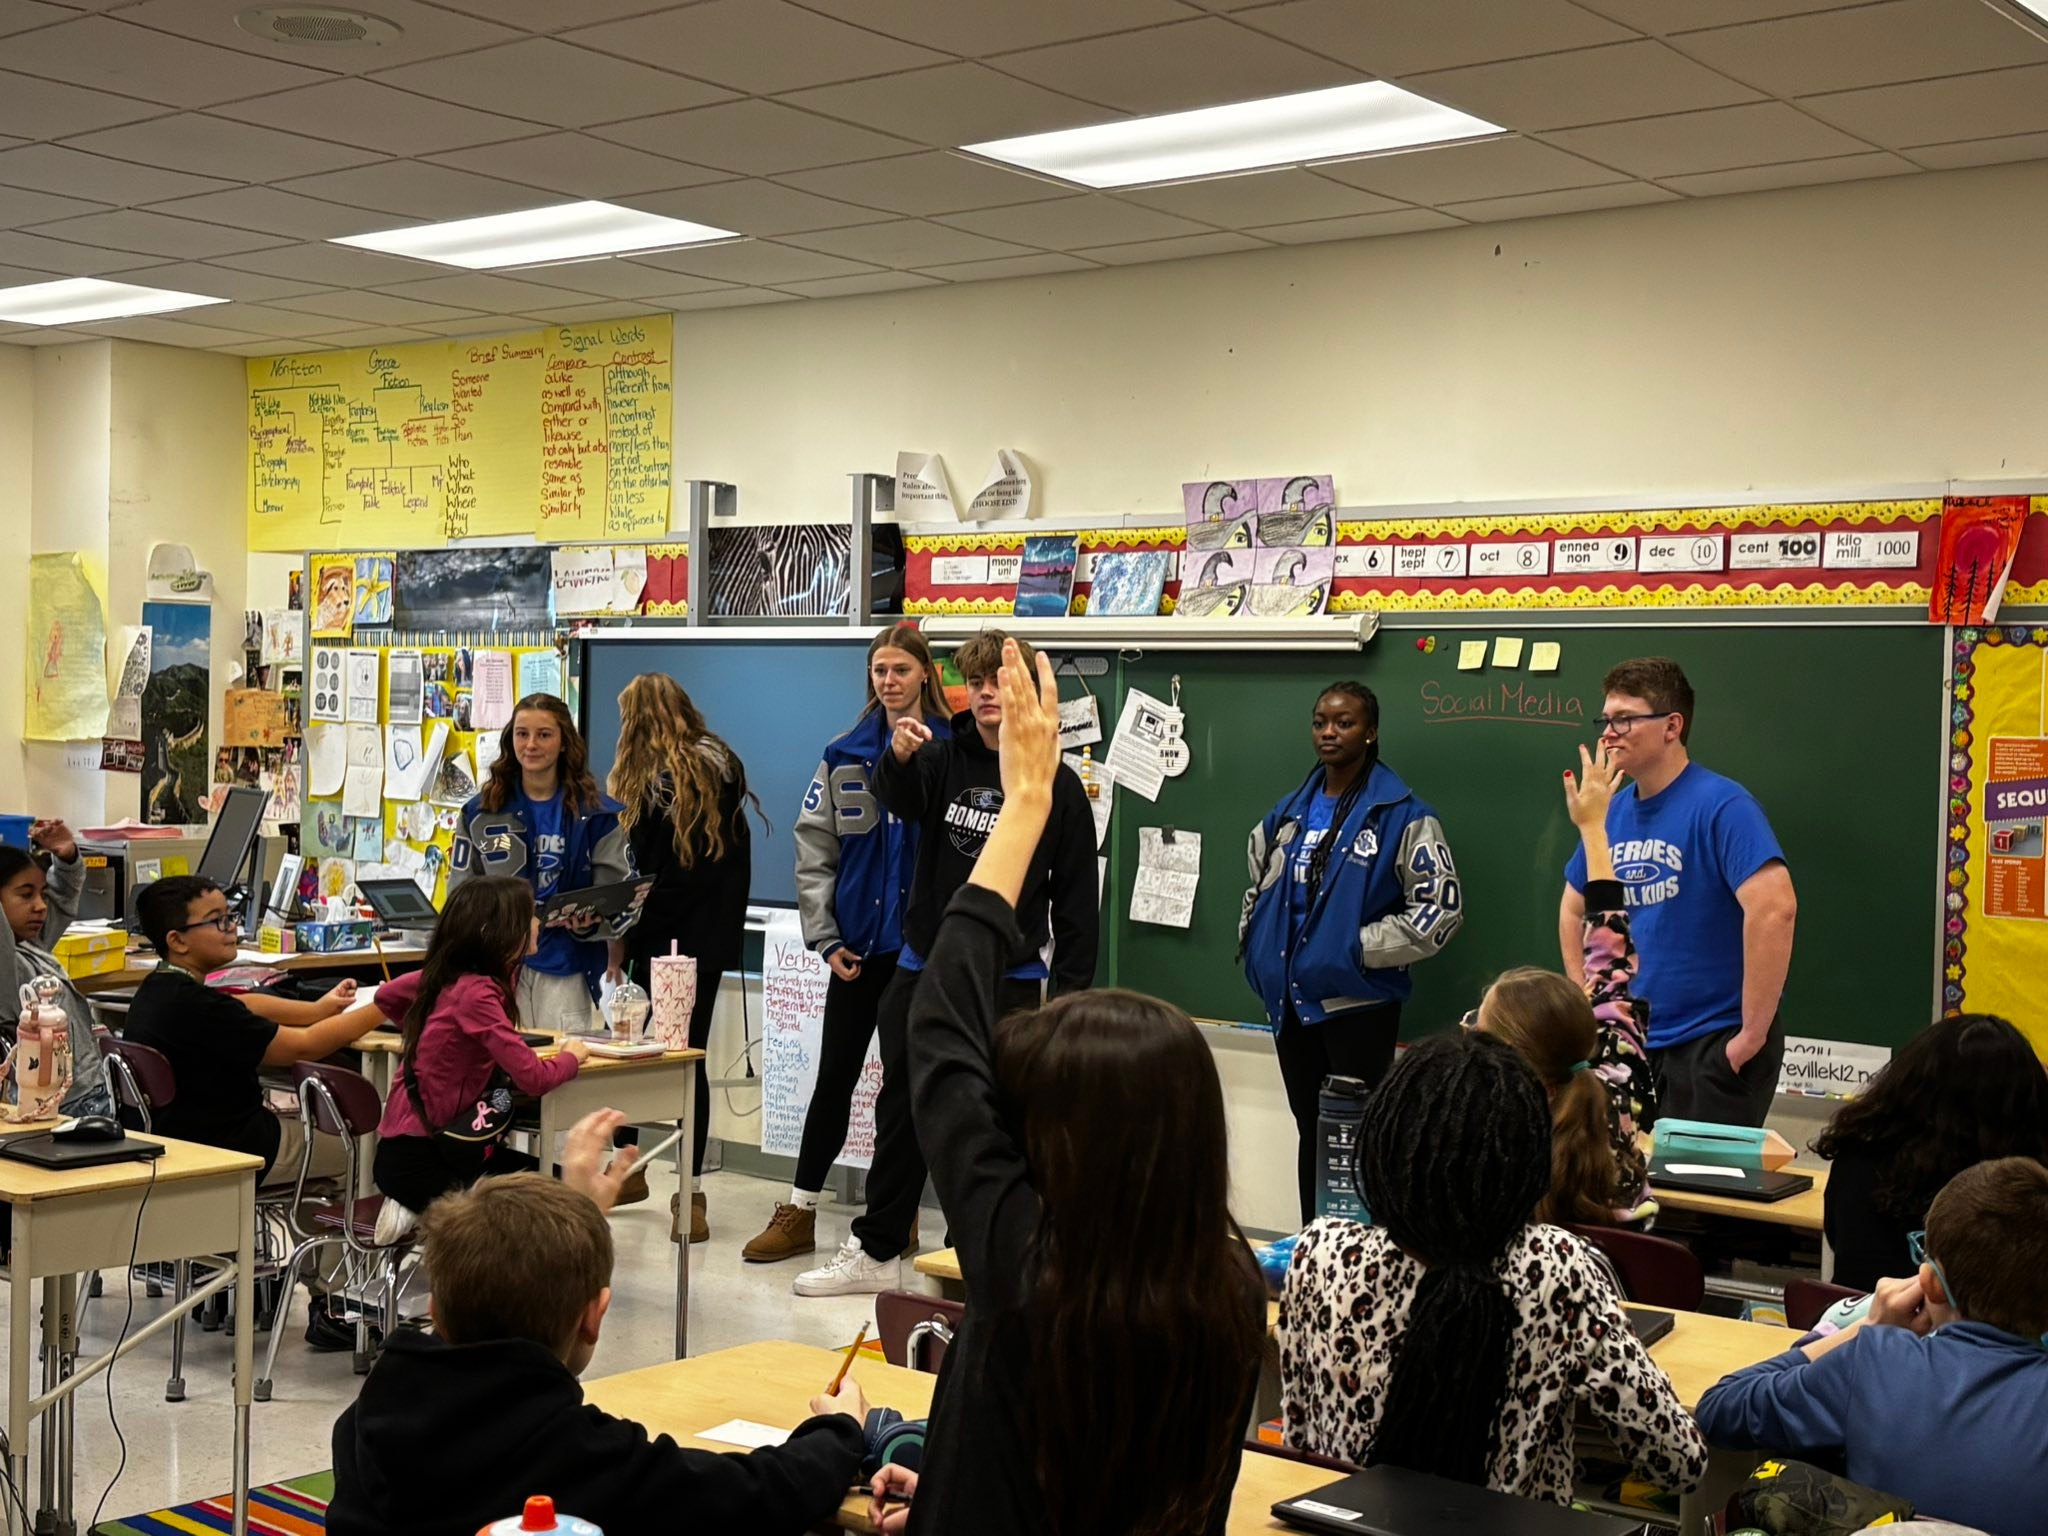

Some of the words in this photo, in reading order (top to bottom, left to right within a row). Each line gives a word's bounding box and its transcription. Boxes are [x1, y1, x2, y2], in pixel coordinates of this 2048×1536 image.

[560, 328, 603, 350] Signal
[611, 325, 646, 343] Words
[466, 346, 498, 363] Brief
[502, 343, 544, 359] Summary
[613, 348, 656, 364] Contrast
[452, 400, 473, 413] But
[452, 413, 466, 425] So
[449, 453, 469, 468] Who
[447, 468, 475, 481] What
[447, 481, 473, 495] When
[577, 485, 585, 498] to
[446, 494, 476, 509] Where
[446, 507, 468, 521] Why
[1559, 541, 1600, 552] ennea
[1837, 534, 1862, 546] kilo
[1877, 540, 1911, 555] 1000
[1401, 547, 1427, 559] hept
[1566, 553, 1591, 564] non
[1614, 543, 1629, 561] 9
[1649, 545, 1675, 557] dec
[1697, 543, 1713, 559] 10
[1738, 541, 1769, 554] cent
[1780, 540, 1817, 557] 100
[992, 558, 1018, 566] mono
[1335, 555, 1349, 563] ex
[1368, 551, 1378, 568] 6
[1400, 557, 1425, 570] sept
[1444, 551, 1454, 568] 7
[1480, 551, 1500, 562] oct
[1523, 551, 1533, 566] 8
[998, 567, 1011, 576] uni
[1421, 680, 1492, 716] Social
[1502, 681, 1584, 717] Media
[1160, 750, 1180, 758] SNOW
[803, 779, 825, 813] 5
[830, 764, 880, 836] S
[1625, 865, 1647, 879] and
[1641, 875, 1680, 906] KIDS
[775, 942, 820, 970] Verbs
